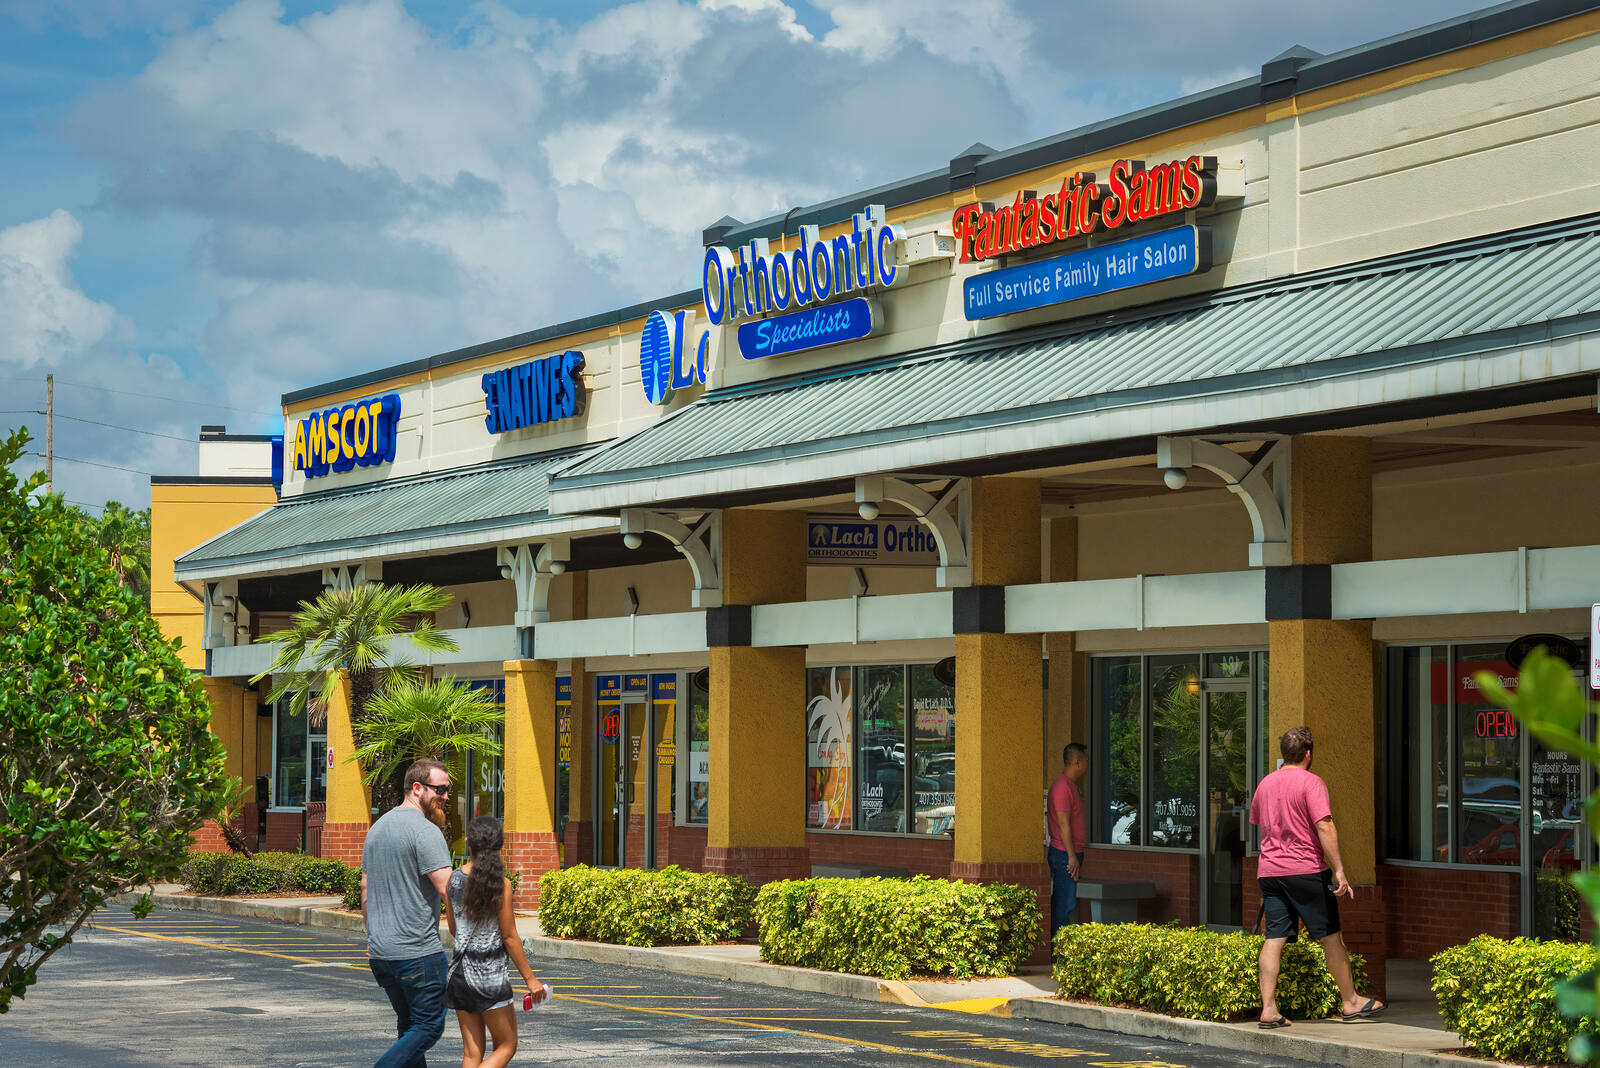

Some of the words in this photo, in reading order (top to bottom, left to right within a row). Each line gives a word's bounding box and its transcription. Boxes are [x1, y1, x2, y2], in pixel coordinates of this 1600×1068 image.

[953, 172, 1100, 264] Fantastic
[1102, 156, 1206, 230] Sams
[702, 204, 899, 326] Orthodontic
[969, 286, 991, 309] Full
[995, 275, 1051, 303] Service
[1055, 262, 1100, 291] Family
[1105, 252, 1139, 278] Hair
[1143, 242, 1188, 270] Salon
[755, 309, 852, 353] Specialists
[293, 401, 383, 471] AMSCOT
[830, 526, 874, 545] Lach
[808, 549, 878, 557] ORTHODONTICS
[602, 714, 621, 737] OPE
[1476, 711, 1515, 737] OPEN
[1532, 762, 1561, 774] Fantastic
[1561, 761, 1580, 774] Sams
[1547, 751, 1568, 760] HOURS
[866, 783, 884, 797] Lach
